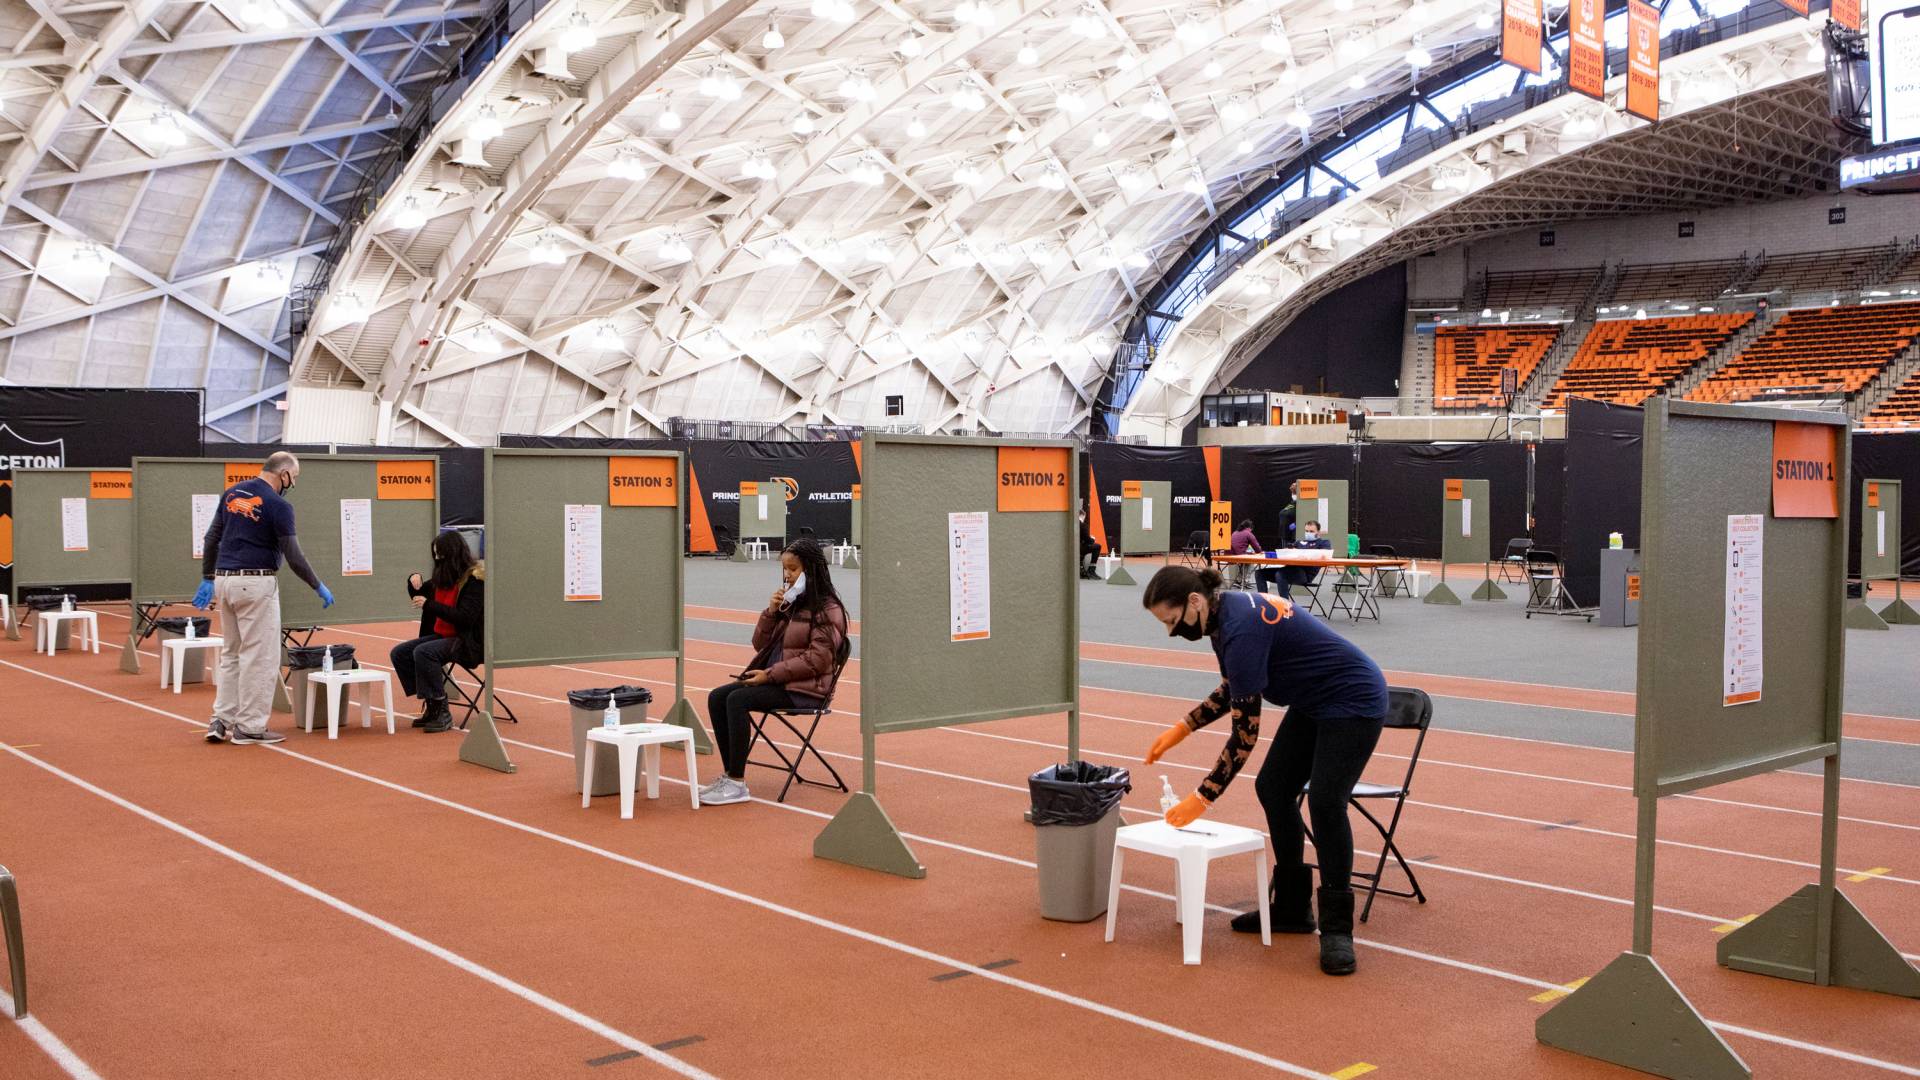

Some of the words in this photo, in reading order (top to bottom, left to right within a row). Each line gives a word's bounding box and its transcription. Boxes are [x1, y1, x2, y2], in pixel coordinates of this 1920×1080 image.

[1776, 459, 1823, 480] STATION
[1827, 461, 1834, 481] 1
[380, 475, 422, 485] STATION
[424, 475, 432, 485] 4
[613, 476, 661, 487] STATION
[665, 477, 673, 487] 3
[1002, 472, 1053, 487] STATION
[1057, 473, 1065, 487] 2
[1212, 512, 1230, 524] POD
[1218, 527, 1224, 539] 4
